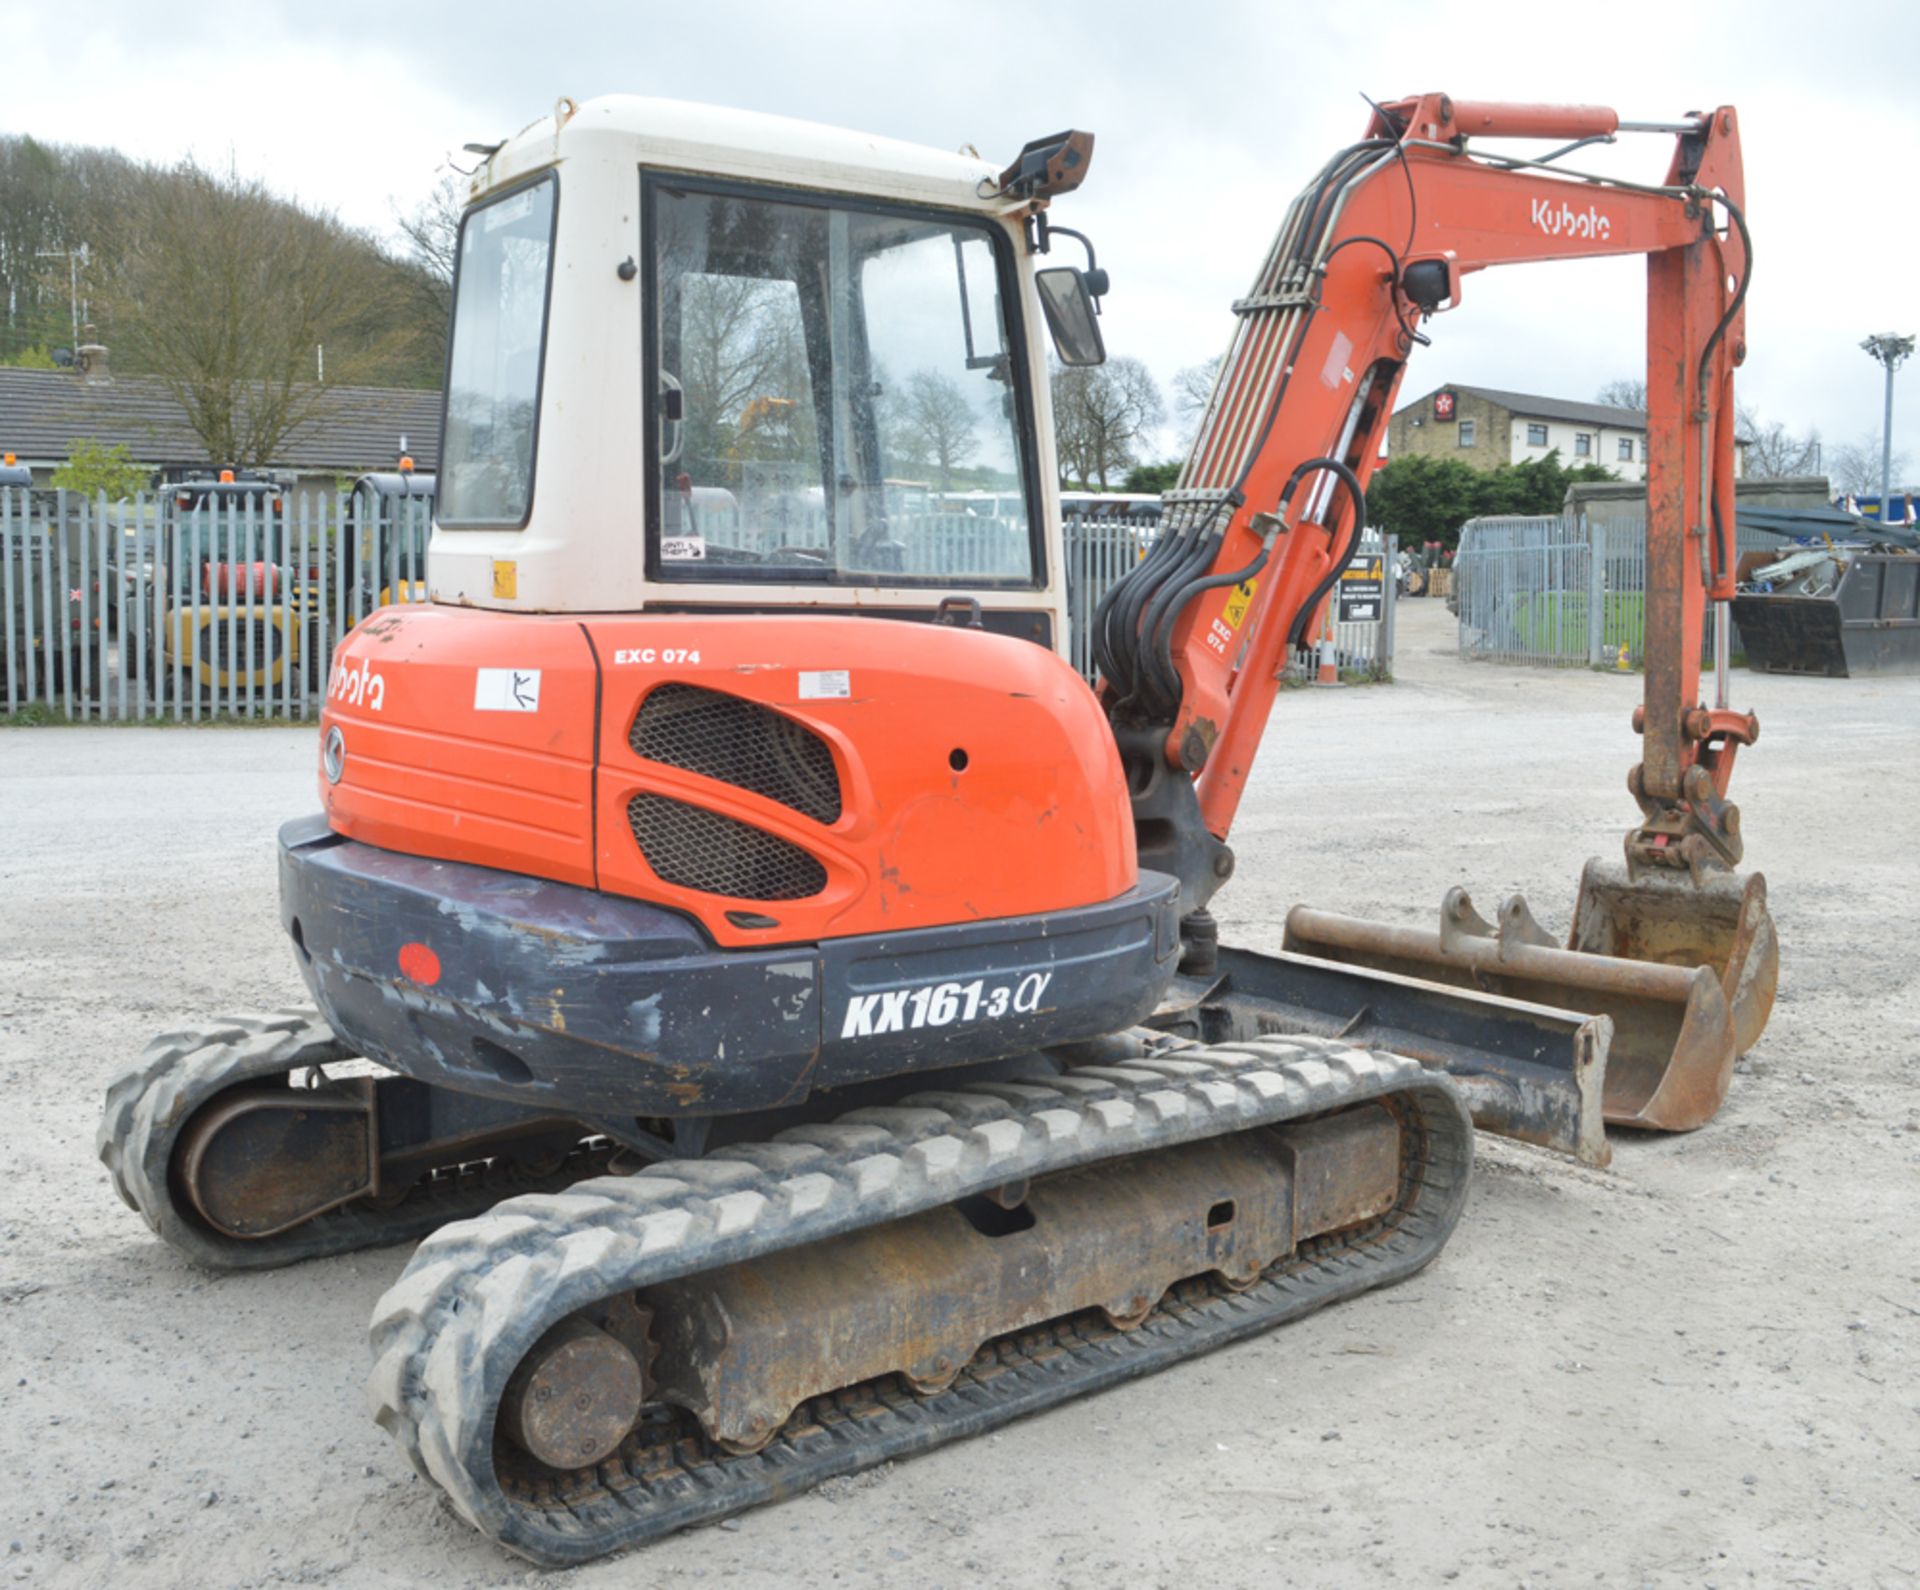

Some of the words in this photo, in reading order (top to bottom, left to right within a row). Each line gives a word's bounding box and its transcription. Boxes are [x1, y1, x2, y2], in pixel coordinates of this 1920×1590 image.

[1531, 198, 1611, 240] Kubota
[614, 648, 656, 664] EXC
[662, 648, 700, 664] 074
